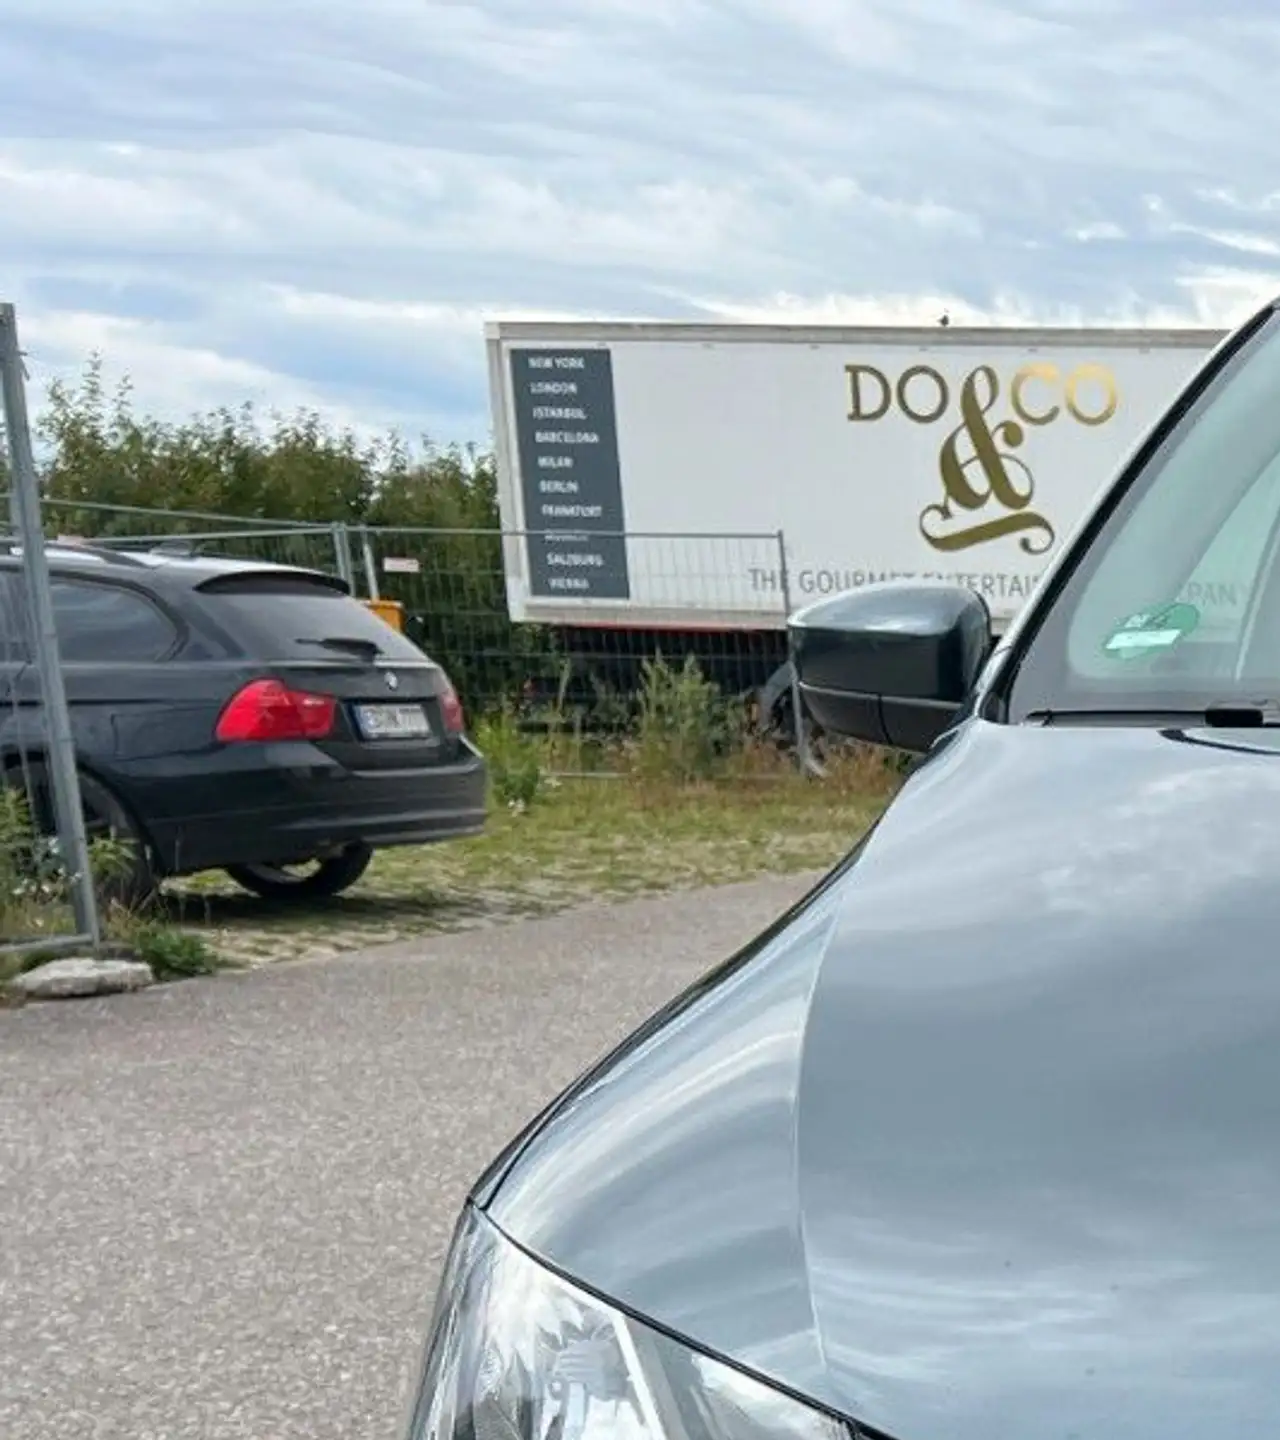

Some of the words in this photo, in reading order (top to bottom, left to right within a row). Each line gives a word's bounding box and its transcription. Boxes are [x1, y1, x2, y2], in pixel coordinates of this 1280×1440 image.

[529, 357, 553, 369] NEW
[555, 357, 585, 369] YORK
[531, 381, 577, 395] LONDON
[533, 406, 587, 420] ISTANBUL
[536, 430, 600, 444] BARCELONA
[539, 455, 574, 469] MILAN
[540, 479, 579, 494] BERLIN
[542, 503, 602, 518] FRANKFURT
[547, 551, 604, 567] SALZBURG
[799, 569, 916, 594] GOUR
